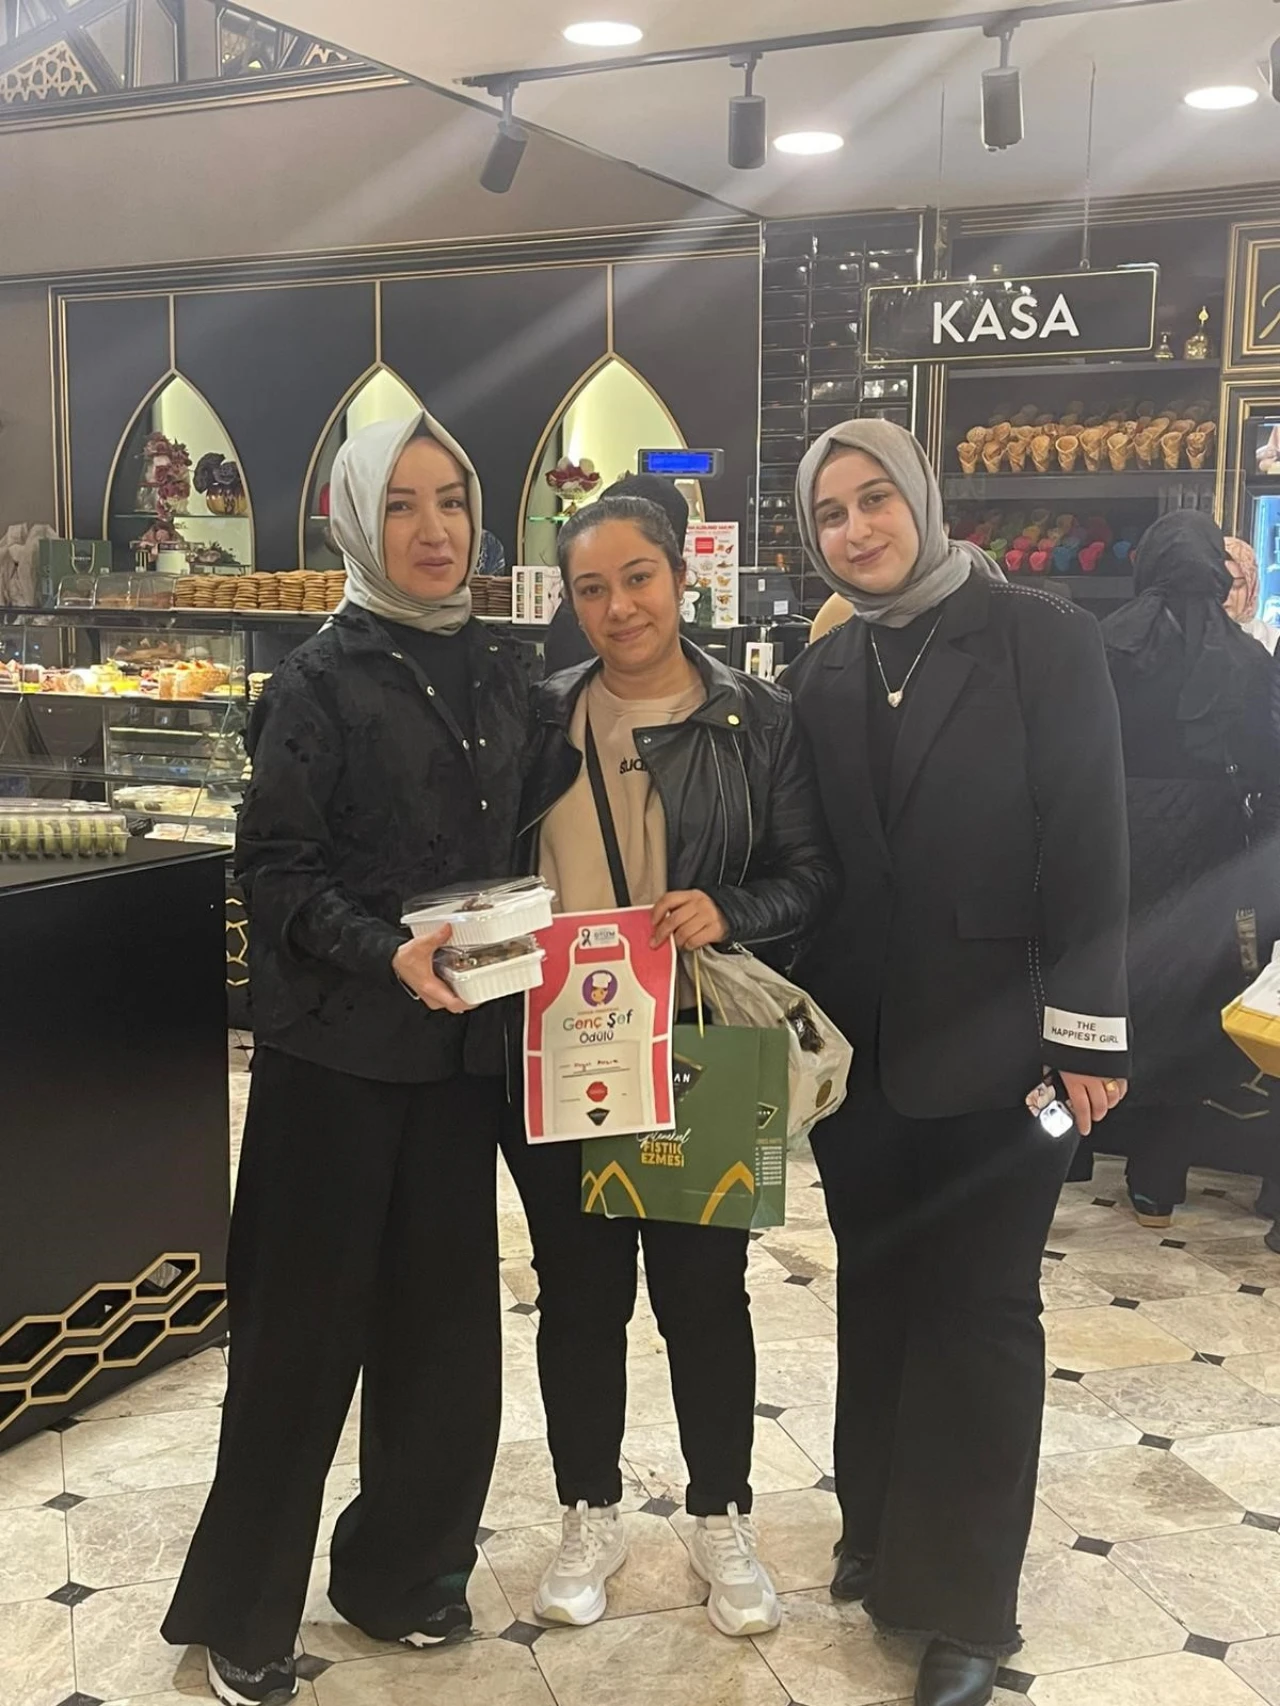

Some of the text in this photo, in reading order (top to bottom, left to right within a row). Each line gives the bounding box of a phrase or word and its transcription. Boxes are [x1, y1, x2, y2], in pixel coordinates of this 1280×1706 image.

[932, 293, 1080, 344] KASA
[1076, 1021, 1096, 1031] THE
[1051, 1027, 1119, 1044] HAPPIEST GIRL
